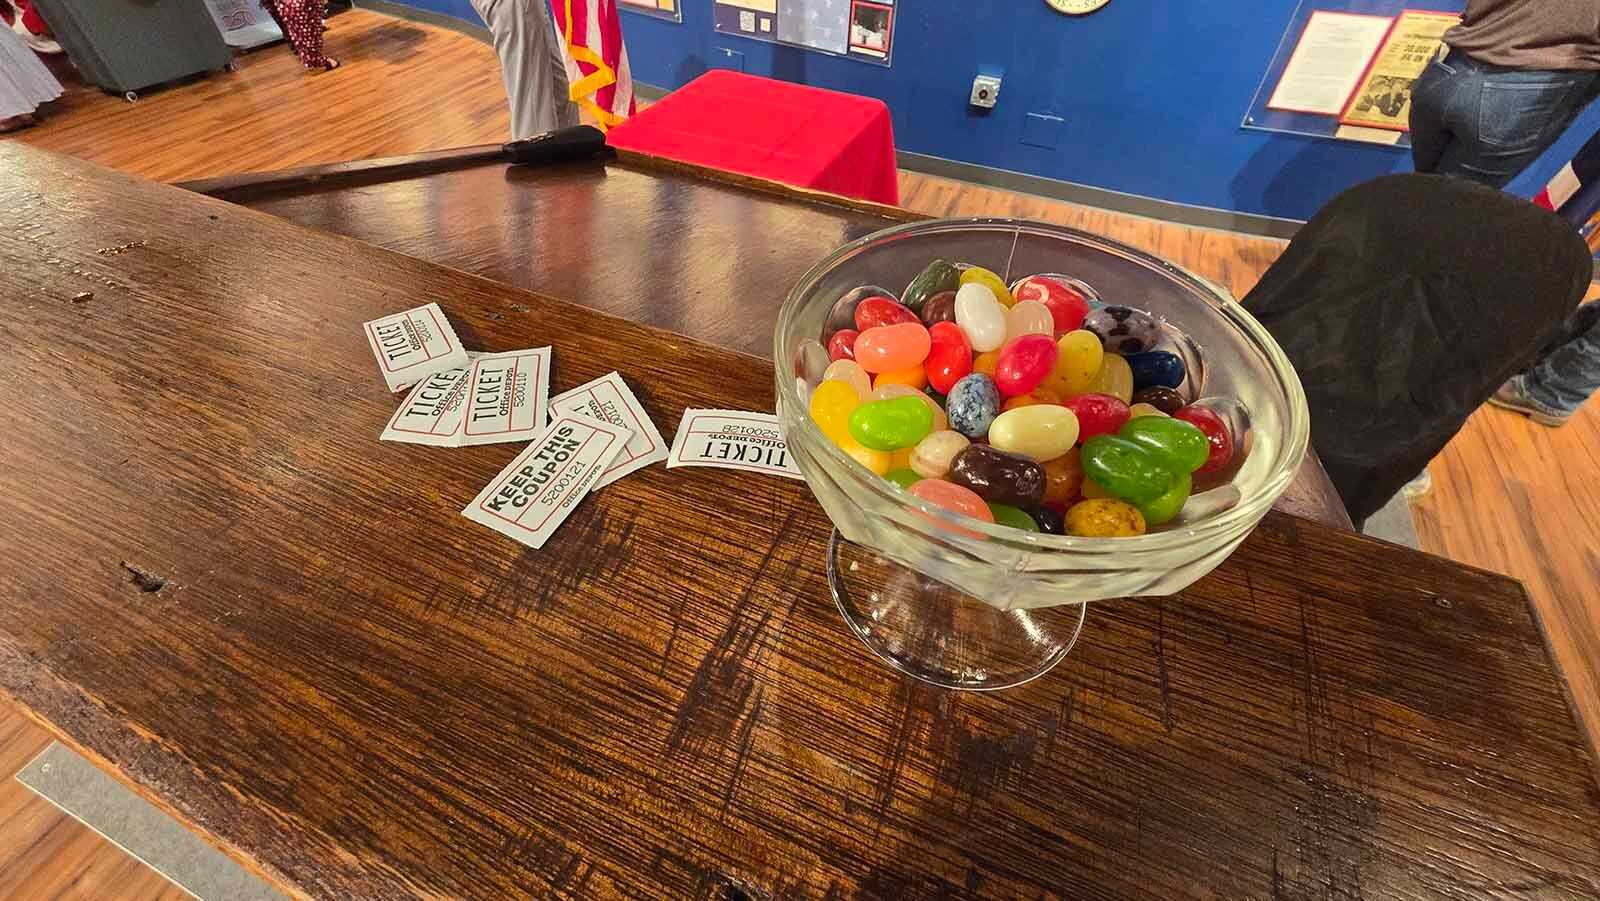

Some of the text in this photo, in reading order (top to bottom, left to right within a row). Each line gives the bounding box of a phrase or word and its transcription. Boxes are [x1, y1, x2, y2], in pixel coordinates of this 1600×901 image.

[375, 321, 411, 361] TICKET
[472, 368, 503, 421] TICKET
[513, 372, 526, 407] 5200110
[487, 424, 574, 512] KEEP THIS
[512, 438, 580, 507] COUPON
[699, 441, 786, 467] TICKET
[541, 459, 586, 506] 5200121
